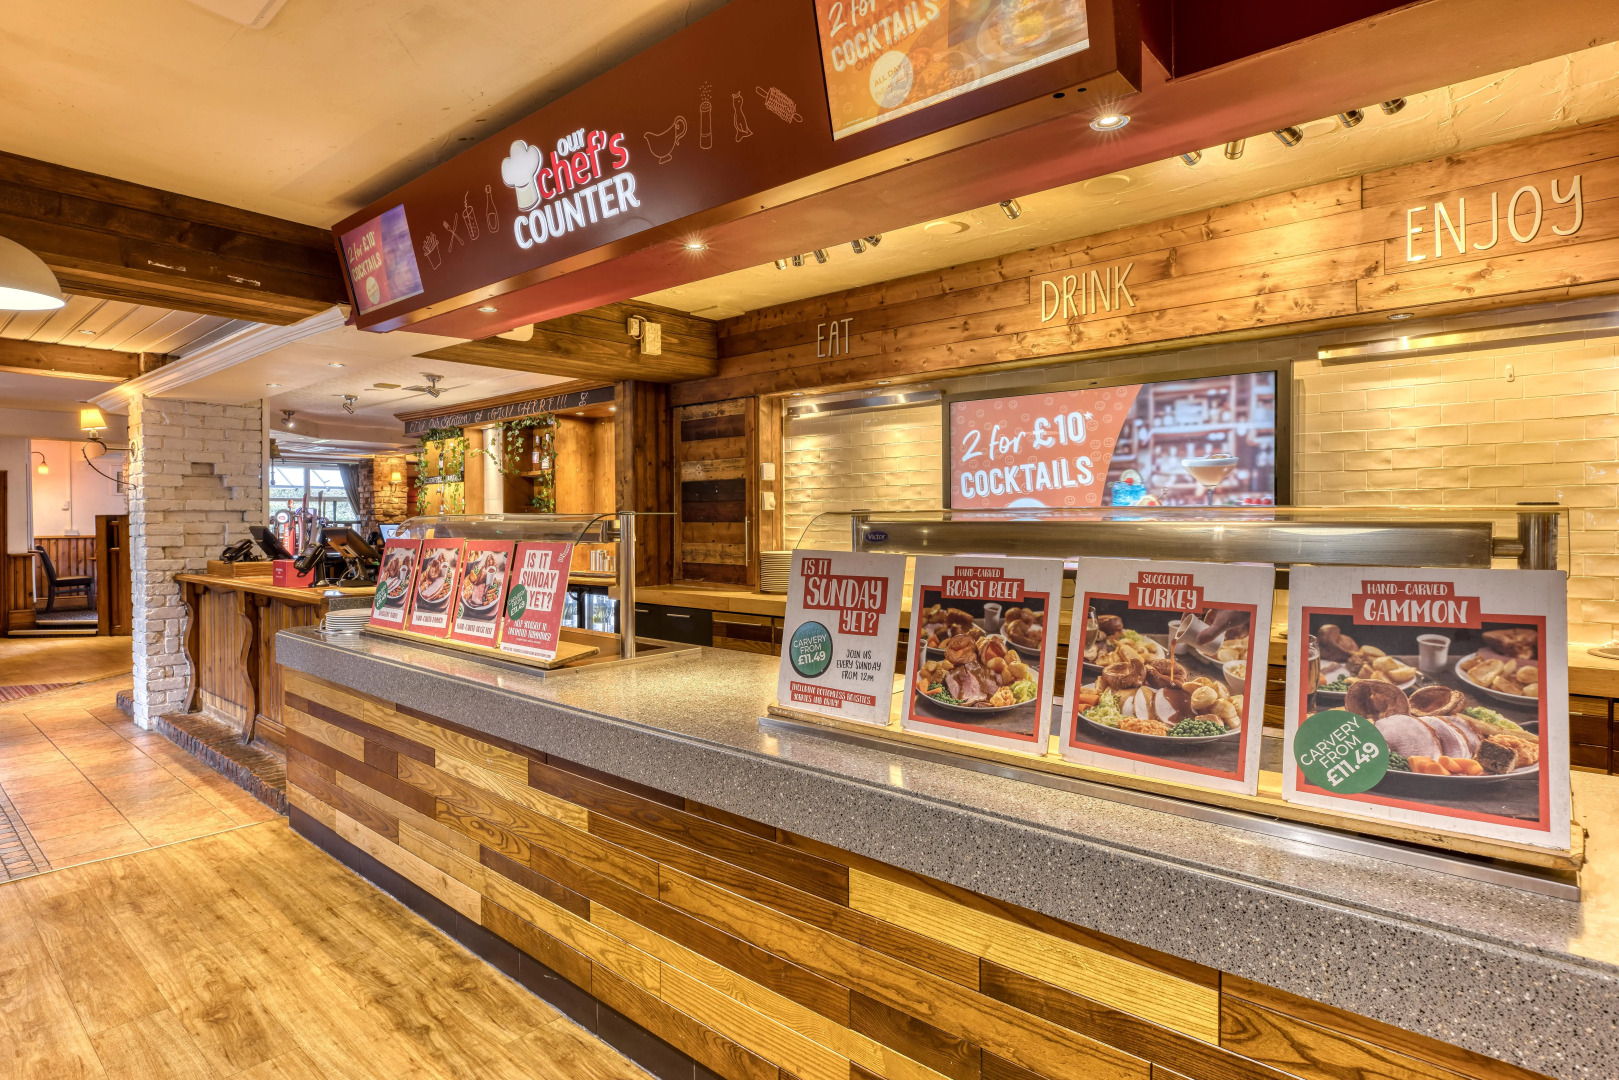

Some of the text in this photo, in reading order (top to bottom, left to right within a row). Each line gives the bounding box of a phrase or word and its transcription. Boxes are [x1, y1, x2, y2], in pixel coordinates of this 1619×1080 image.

[828, 2, 847, 38] 2
[832, 0, 940, 72] COCKTAILS
[557, 128, 584, 156] our
[538, 130, 628, 199] chef's
[514, 172, 640, 249] COUNTER
[348, 246, 354, 264] 2
[352, 252, 382, 282] COCKTAILS
[817, 174, 1584, 358] EAT DRINK ENJOY
[962, 430, 982, 462] 2
[990, 424, 1026, 460] for
[961, 456, 1094, 498] COCKTAILS
[867, 532, 886, 541] Victor
[527, 552, 550, 568] IS IT
[804, 559, 830, 576] IS IT
[522, 571, 556, 589] SUNDAY
[957, 568, 1000, 578] HAND-CARVED
[1142, 574, 1188, 586] SUCCULENT
[806, 576, 882, 610] SUNDAY
[946, 580, 1020, 599] ROAST BEEF
[1136, 586, 1197, 610] TURKEY
[1367, 584, 1448, 596] HAND-CARVED
[530, 591, 552, 610] YET?
[1364, 598, 1468, 624] GAMMON
[842, 610, 876, 633] YET?
[793, 634, 827, 648] CARVERY
[800, 644, 822, 654] FROM
[798, 650, 826, 666] £11.49
[846, 648, 872, 660] JOIN US
[836, 660, 882, 672] EVERY SUNDAY
[842, 670, 858, 680] FROM
[1300, 716, 1360, 766] CARVERY
[1319, 734, 1362, 768] FROM
[1326, 742, 1380, 787] £11.49
